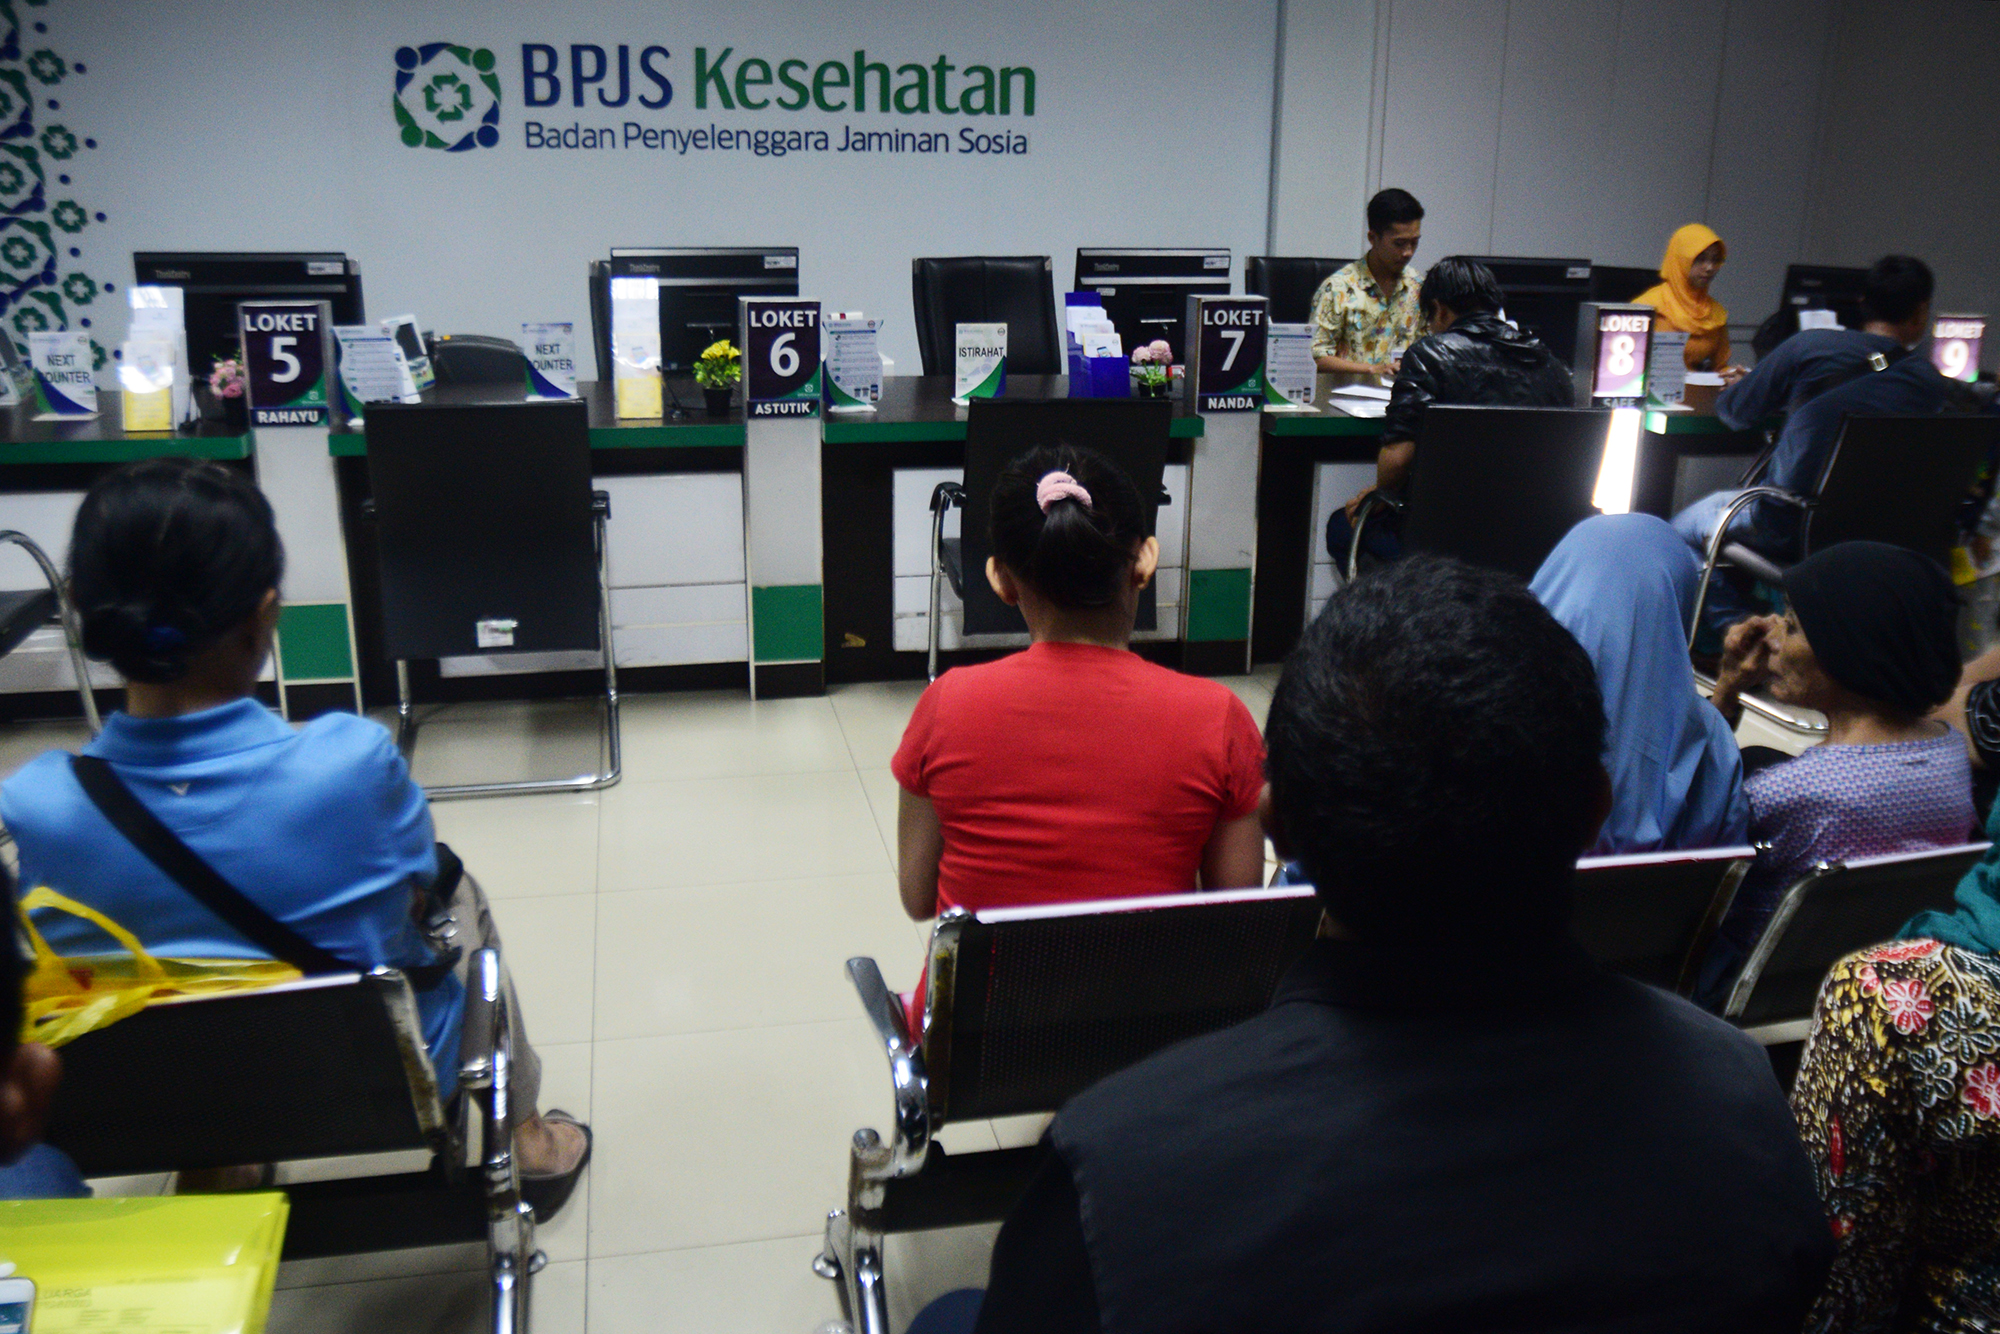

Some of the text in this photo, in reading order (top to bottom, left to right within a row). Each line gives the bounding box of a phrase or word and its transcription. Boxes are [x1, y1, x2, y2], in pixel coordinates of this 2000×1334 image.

[522, 43, 1036, 117] BPJS Kesehatan
[525, 121, 1028, 156] Badan Penyelenggara Jaminan Sosia
[245, 313, 317, 332] LOKET
[750, 310, 817, 328] LOKET
[1203, 309, 1263, 326] LOKET
[1600, 314, 1652, 332] LOKET
[535, 344, 561, 355] NEXT
[770, 332, 800, 377] 6
[958, 347, 1004, 357] ISTIRAHAT
[1221, 330, 1245, 371] 7
[1608, 334, 1636, 376] 8
[1941, 339, 1969, 378] 9
[47, 354, 76, 366] NEXT
[272, 336, 301, 383] 5
[532, 359, 573, 371] OUNTER
[44, 371, 91, 383] OUNTER
[755, 402, 811, 415] ASTUTIK
[1208, 397, 1255, 409] NANDA
[256, 410, 319, 423] RAHAYU
